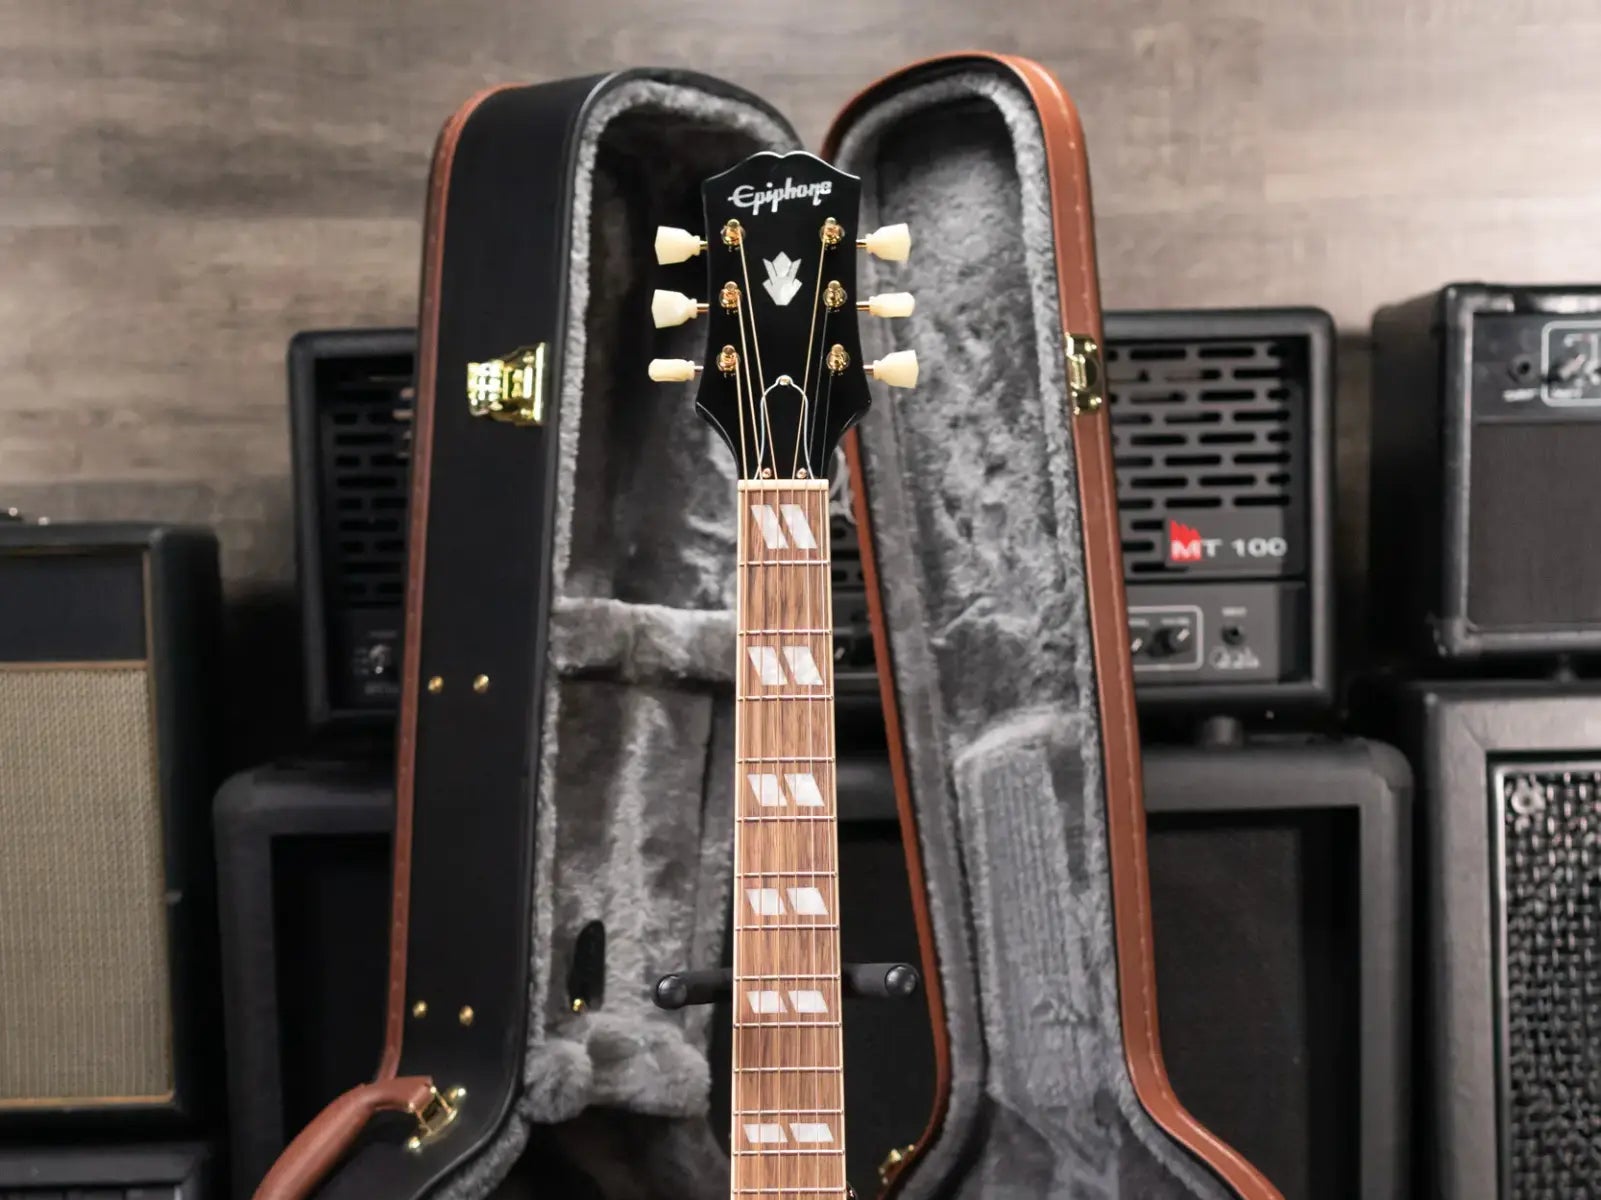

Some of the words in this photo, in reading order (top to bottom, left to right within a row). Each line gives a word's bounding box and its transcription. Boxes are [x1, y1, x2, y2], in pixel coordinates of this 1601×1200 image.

[727, 177, 833, 216] Epiphone
[1171, 538, 1222, 560] MT
[1231, 536, 1288, 558] 100
